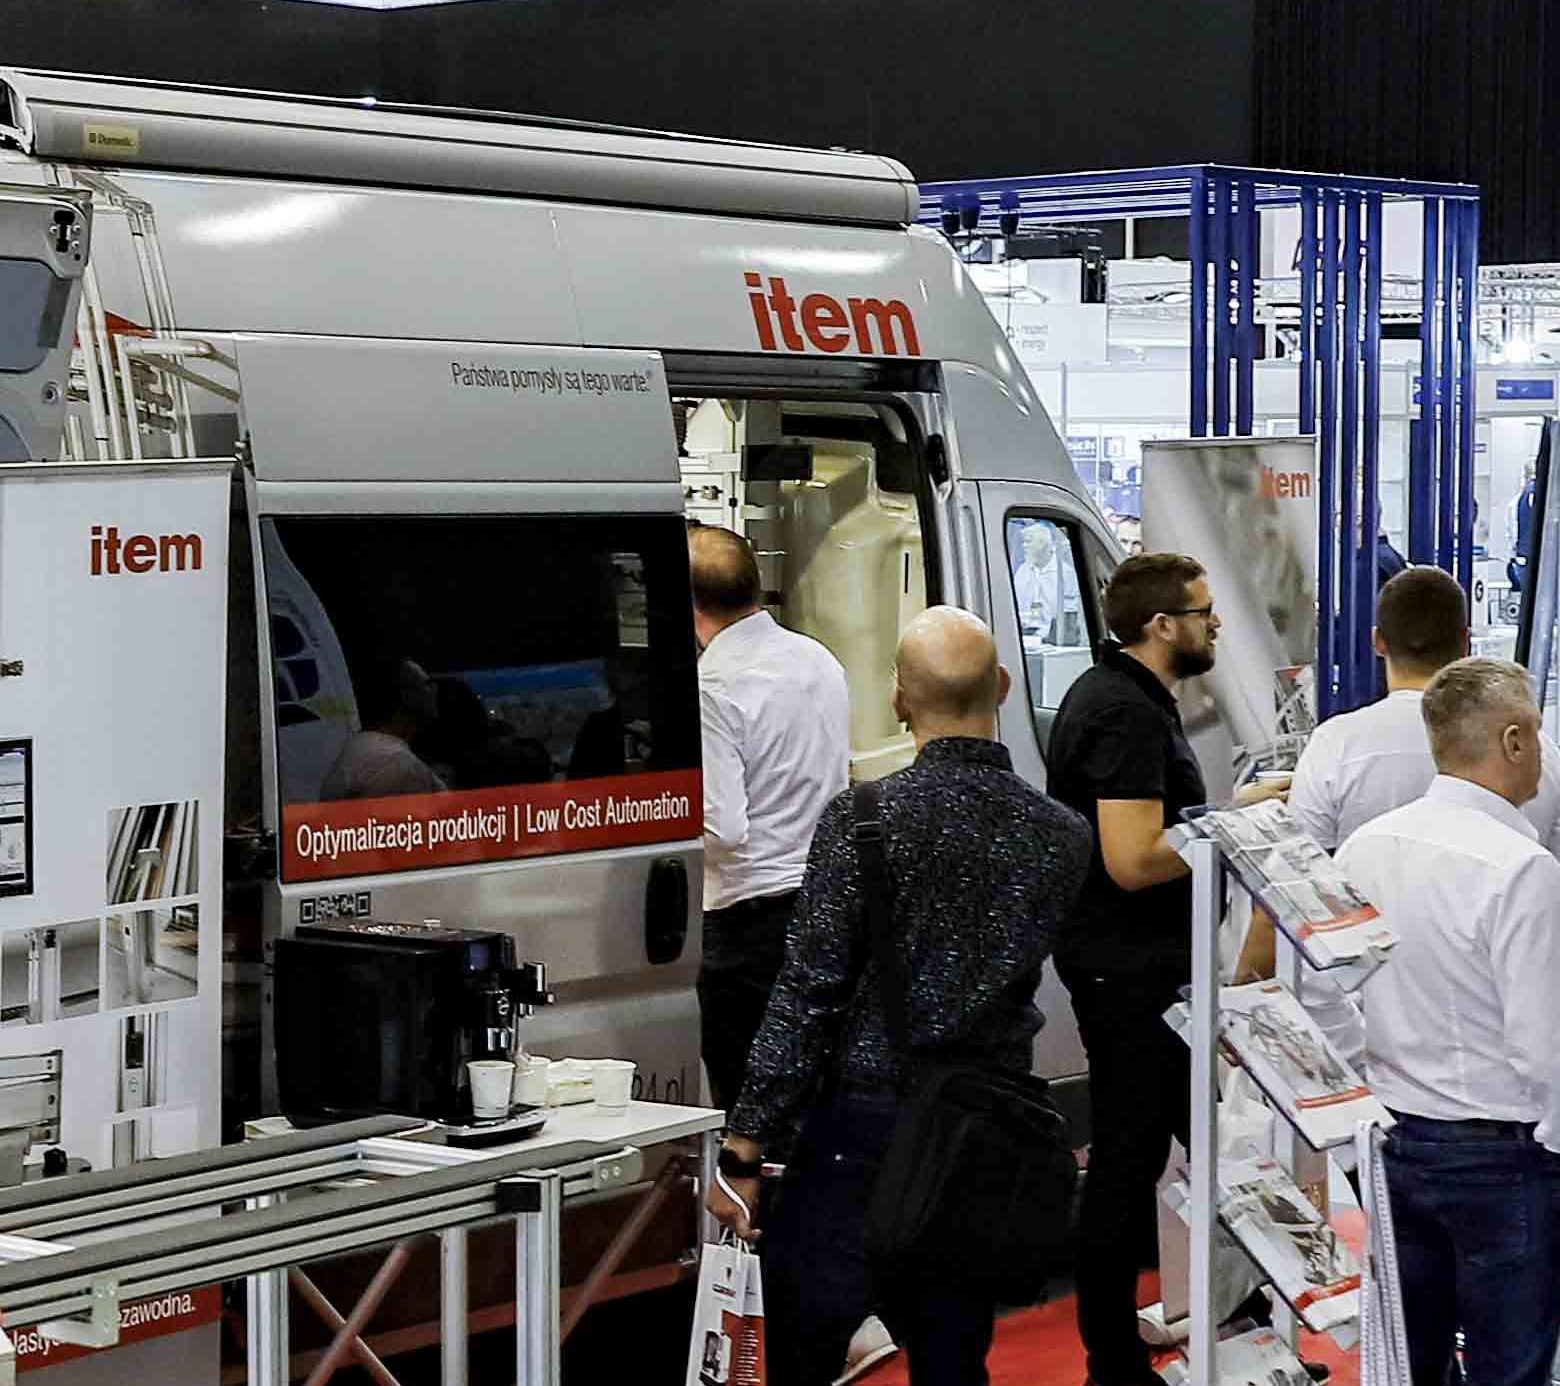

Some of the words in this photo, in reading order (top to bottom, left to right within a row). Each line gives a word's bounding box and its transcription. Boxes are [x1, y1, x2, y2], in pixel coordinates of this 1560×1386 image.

[744, 272, 920, 356] item
[451, 362, 509, 388] Państwa
[511, 366, 562, 395] pomysły
[563, 370, 581, 394] są
[582, 369, 612, 396] tego
[91, 526, 202, 575] item
[296, 814, 423, 861] Optymalizacja
[428, 807, 507, 850] produkcji
[527, 804, 560, 834] Low
[564, 799, 601, 829] Cost
[605, 792, 689, 823] Automation
